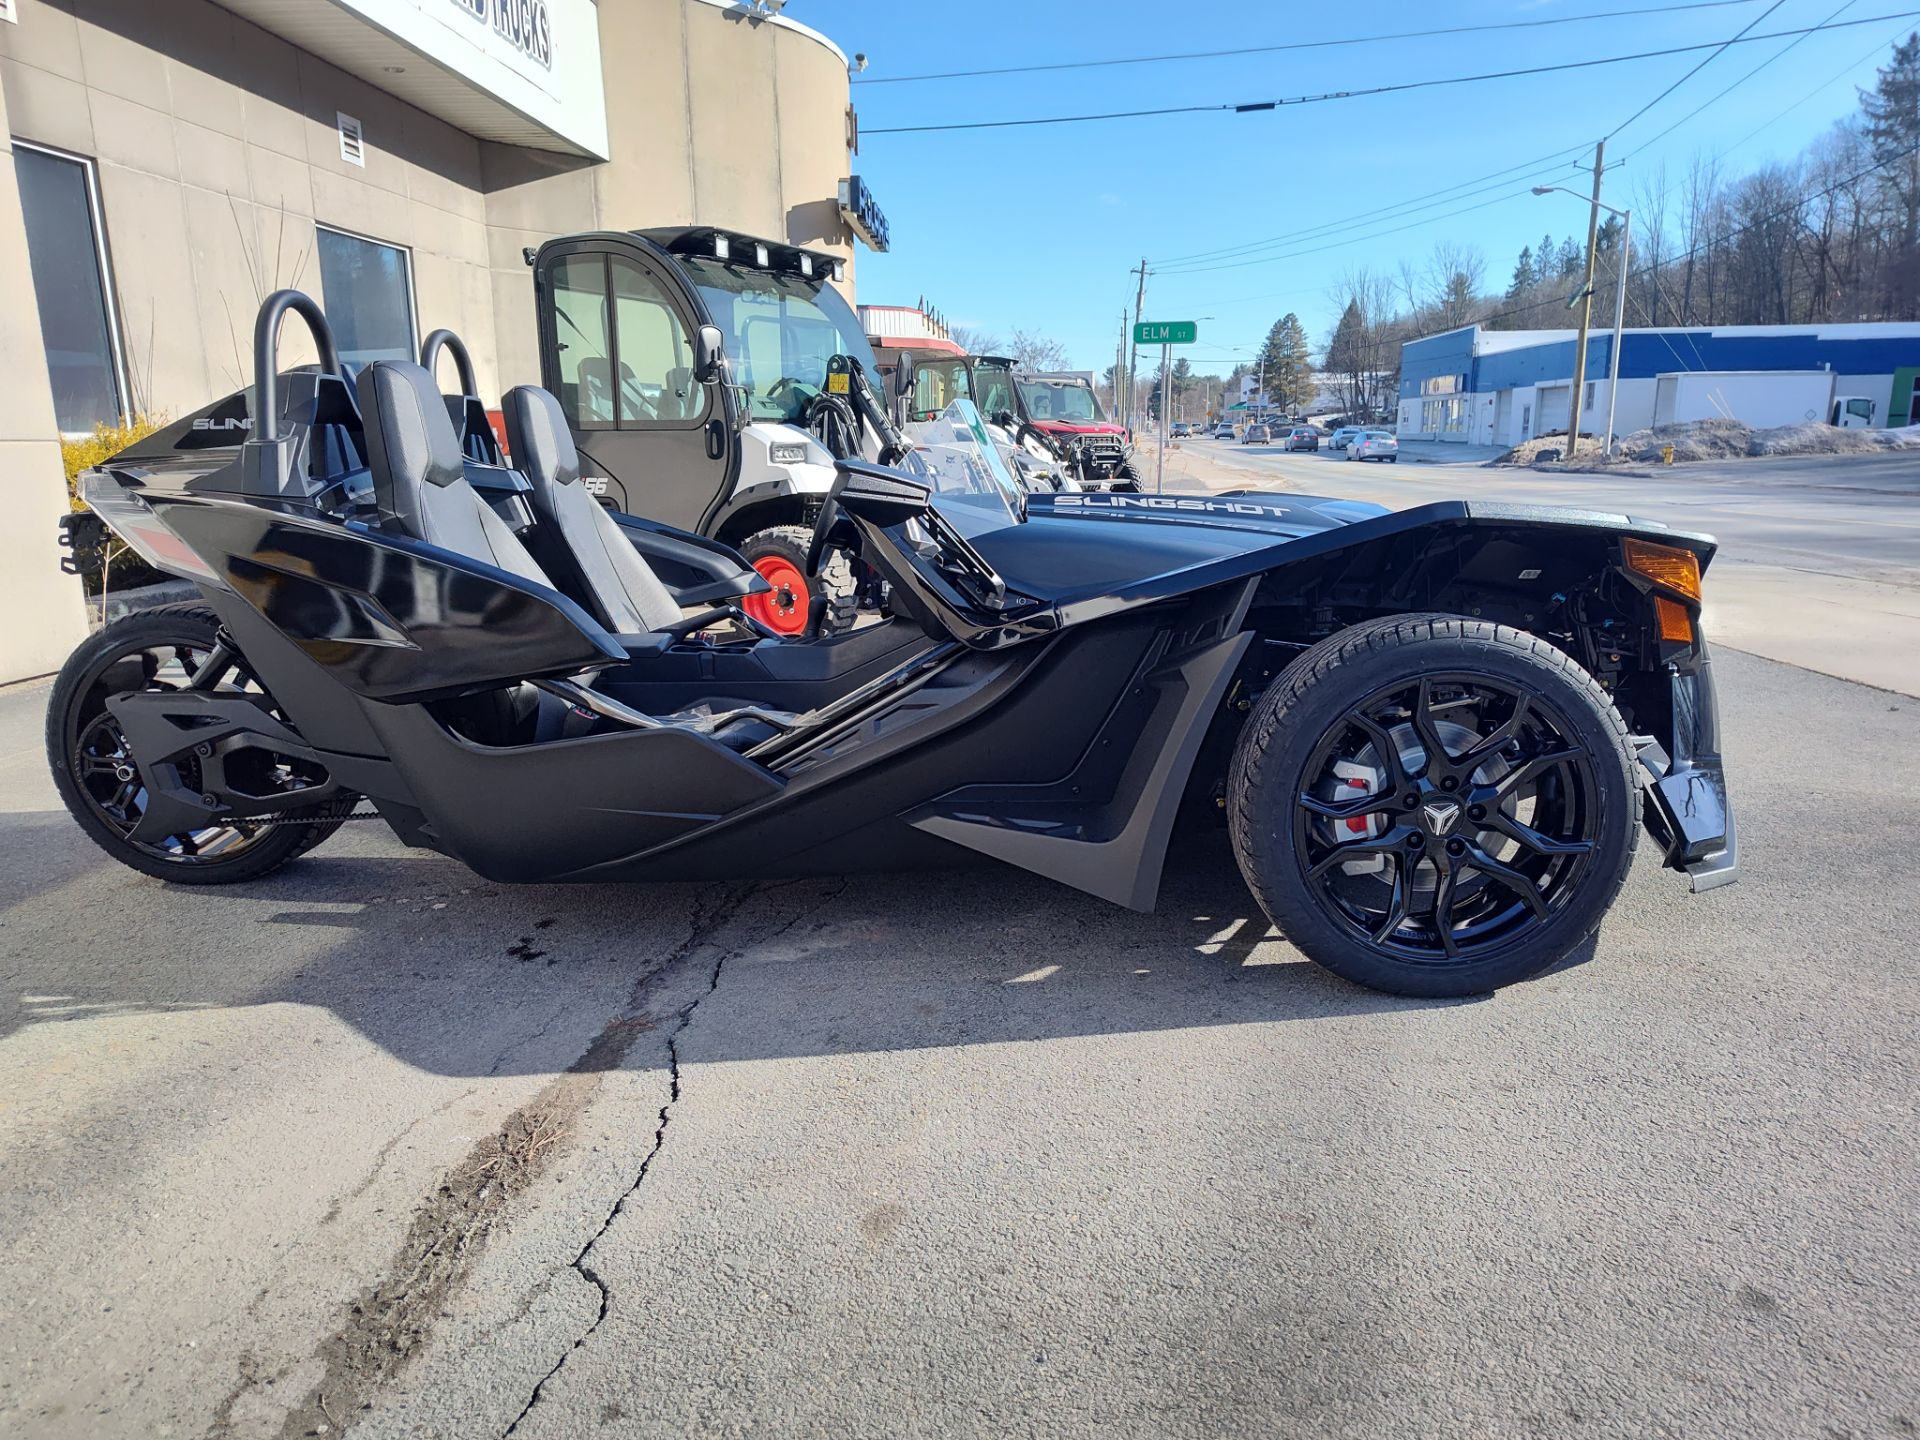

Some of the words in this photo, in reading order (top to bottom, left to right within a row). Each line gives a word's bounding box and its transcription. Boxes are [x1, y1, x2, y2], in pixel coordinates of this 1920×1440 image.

[1142, 326, 1169, 339] ELM
[1177, 331, 1186, 339] ST
[1054, 495, 1292, 517] SLINGSHOT
